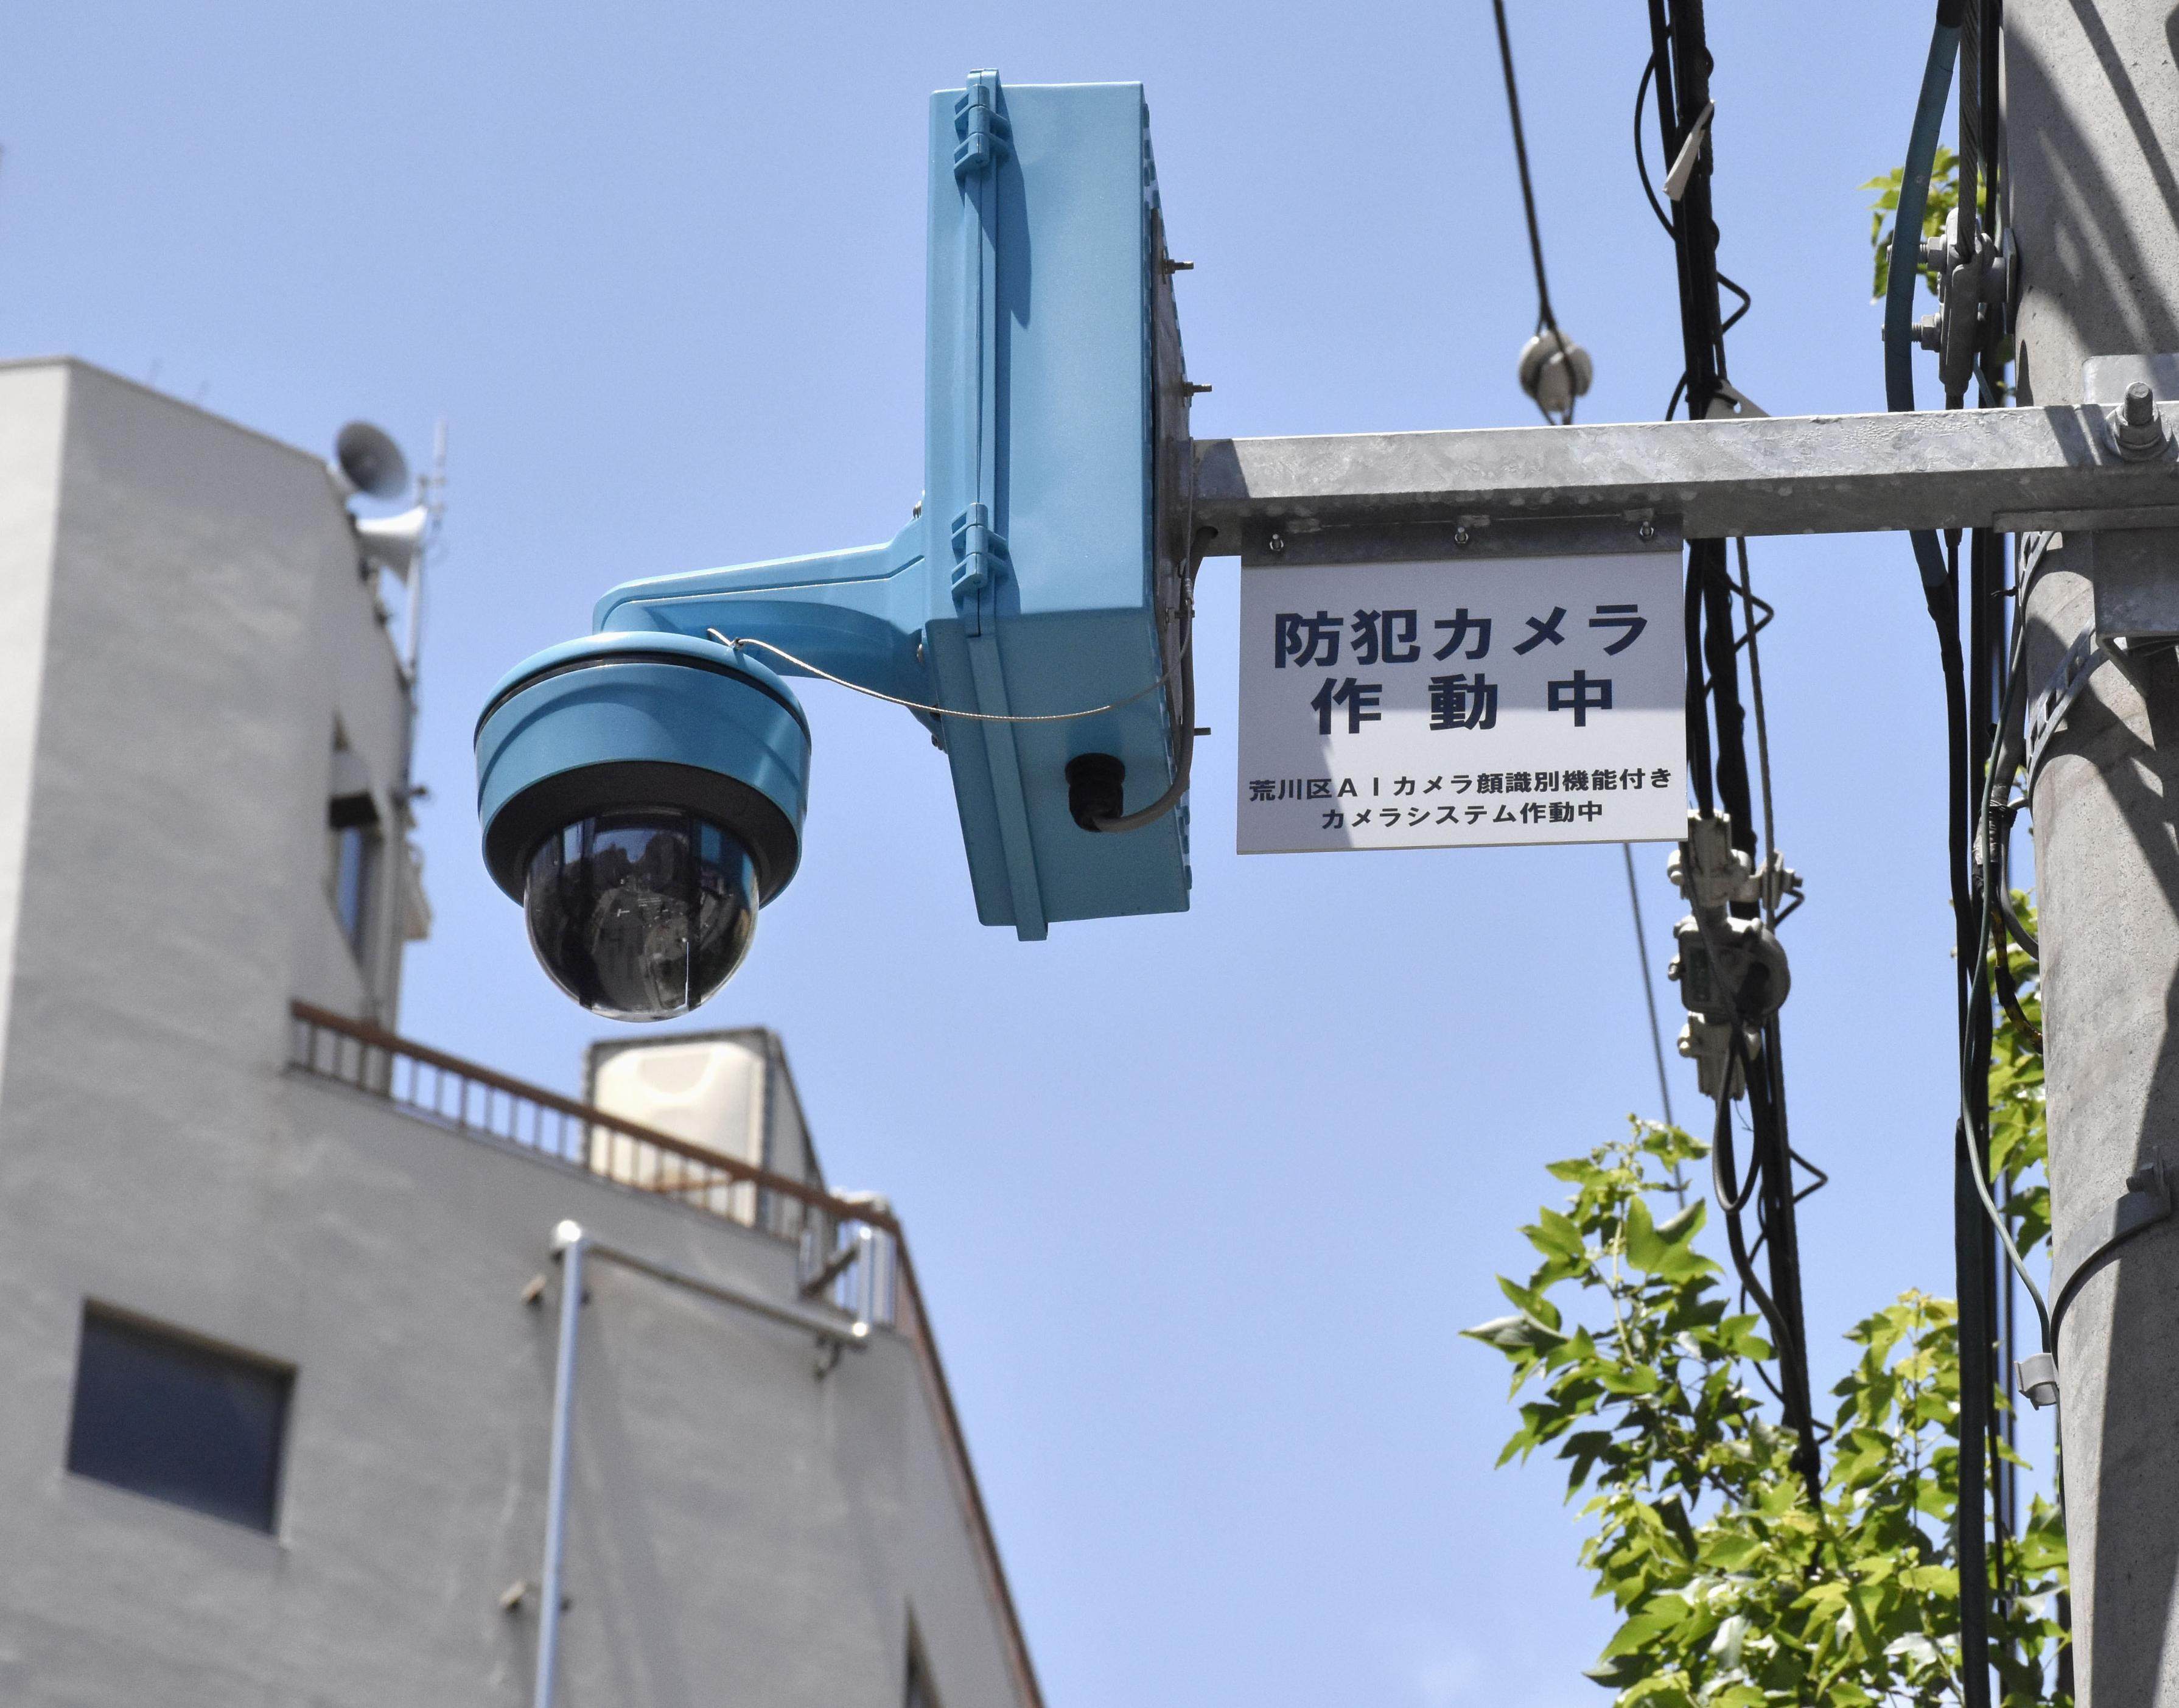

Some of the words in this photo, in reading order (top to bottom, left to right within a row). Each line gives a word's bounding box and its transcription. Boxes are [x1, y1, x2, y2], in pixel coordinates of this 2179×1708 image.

[1275, 604, 1648, 669] 防犯カメラ
[1321, 800, 1603, 830] カメラシステム作動中
